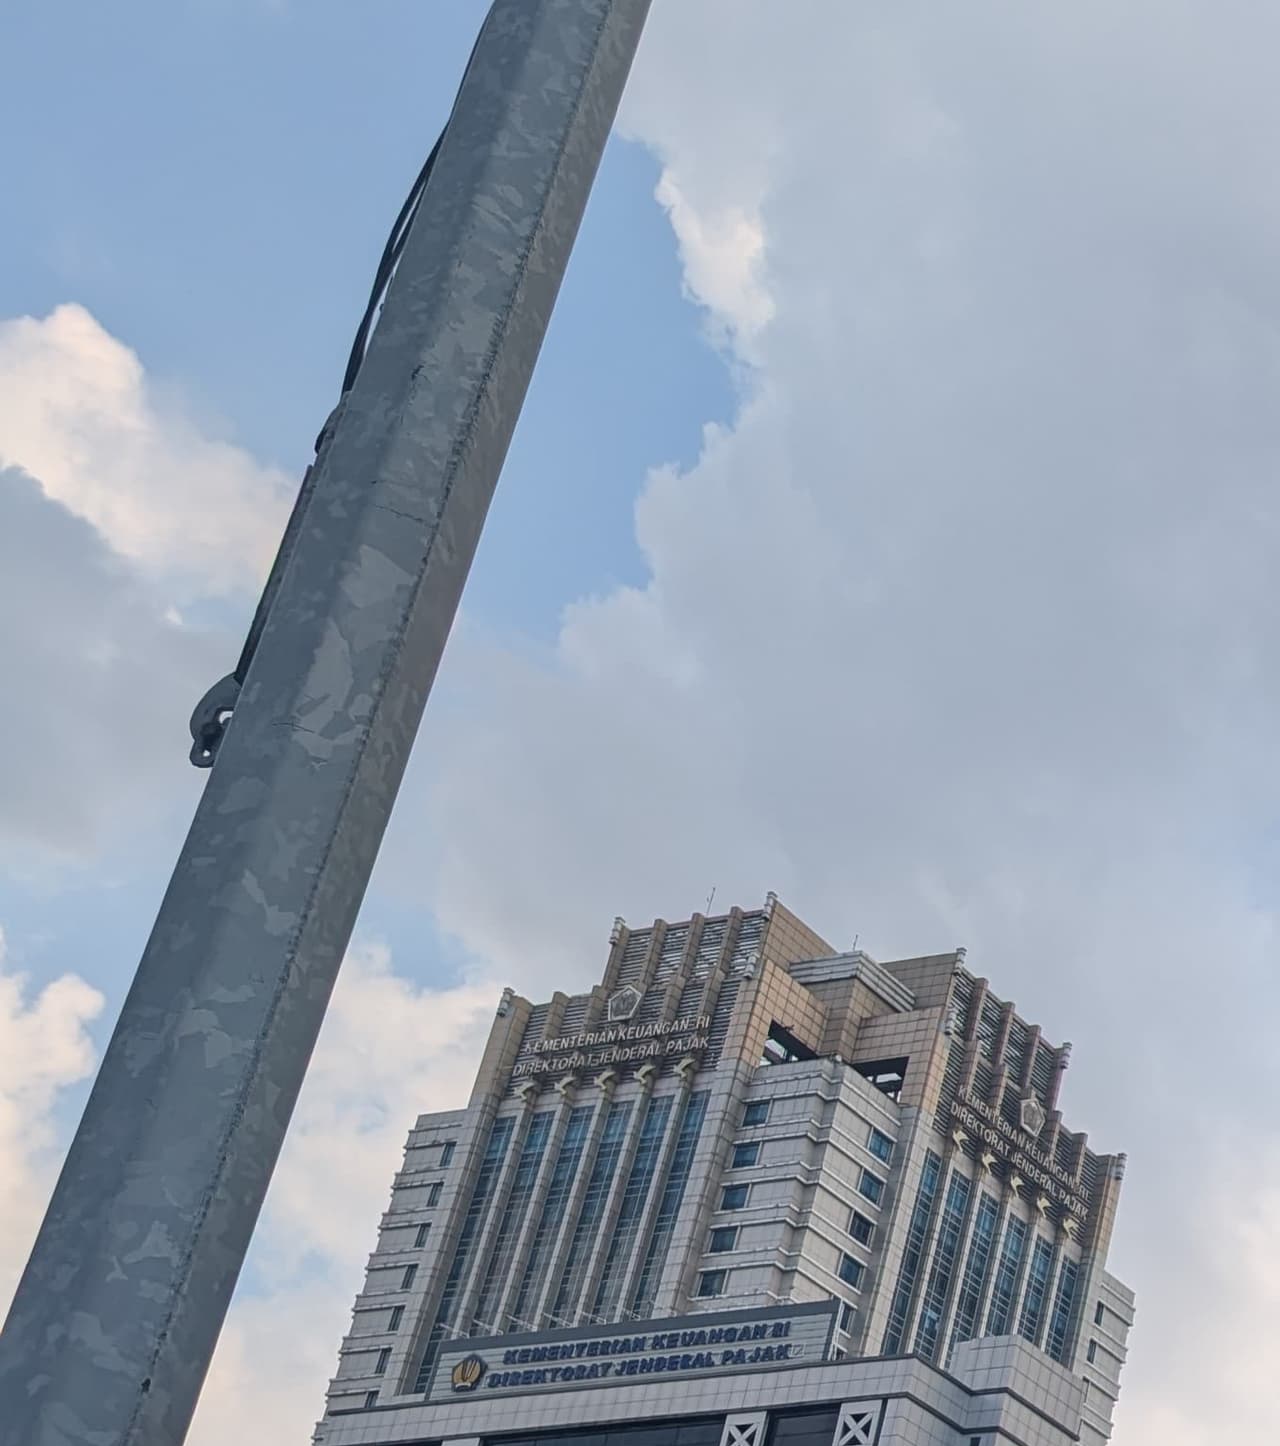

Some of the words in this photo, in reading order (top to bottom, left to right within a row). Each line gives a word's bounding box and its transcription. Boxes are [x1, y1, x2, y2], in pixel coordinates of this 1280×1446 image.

[512, 1053, 593, 1077] DIREKTORAT
[591, 1042, 663, 1066] JENDERAL
[666, 1036, 710, 1055] PAJAK
[525, 1031, 618, 1056] KEMENTERIAN
[618, 1019, 689, 1040] KEUANGAN
[957, 1084, 1026, 1149] KEMENTERIAN
[1025, 1139, 1076, 1190] KEUANGAN
[950, 1101, 1011, 1157] DIREKTORAT
[1010, 1151, 1059, 1198] JENDERAL
[1058, 1187, 1090, 1221] PAJAK
[503, 1336, 647, 1365] KEMENTERIAN
[651, 1323, 768, 1350] KEUANGAN
[771, 1321, 792, 1338] RI
[487, 1361, 613, 1388] DIREKTORAT
[614, 1352, 715, 1377] JENDERAL
[721, 1344, 793, 1366] PAJAK
